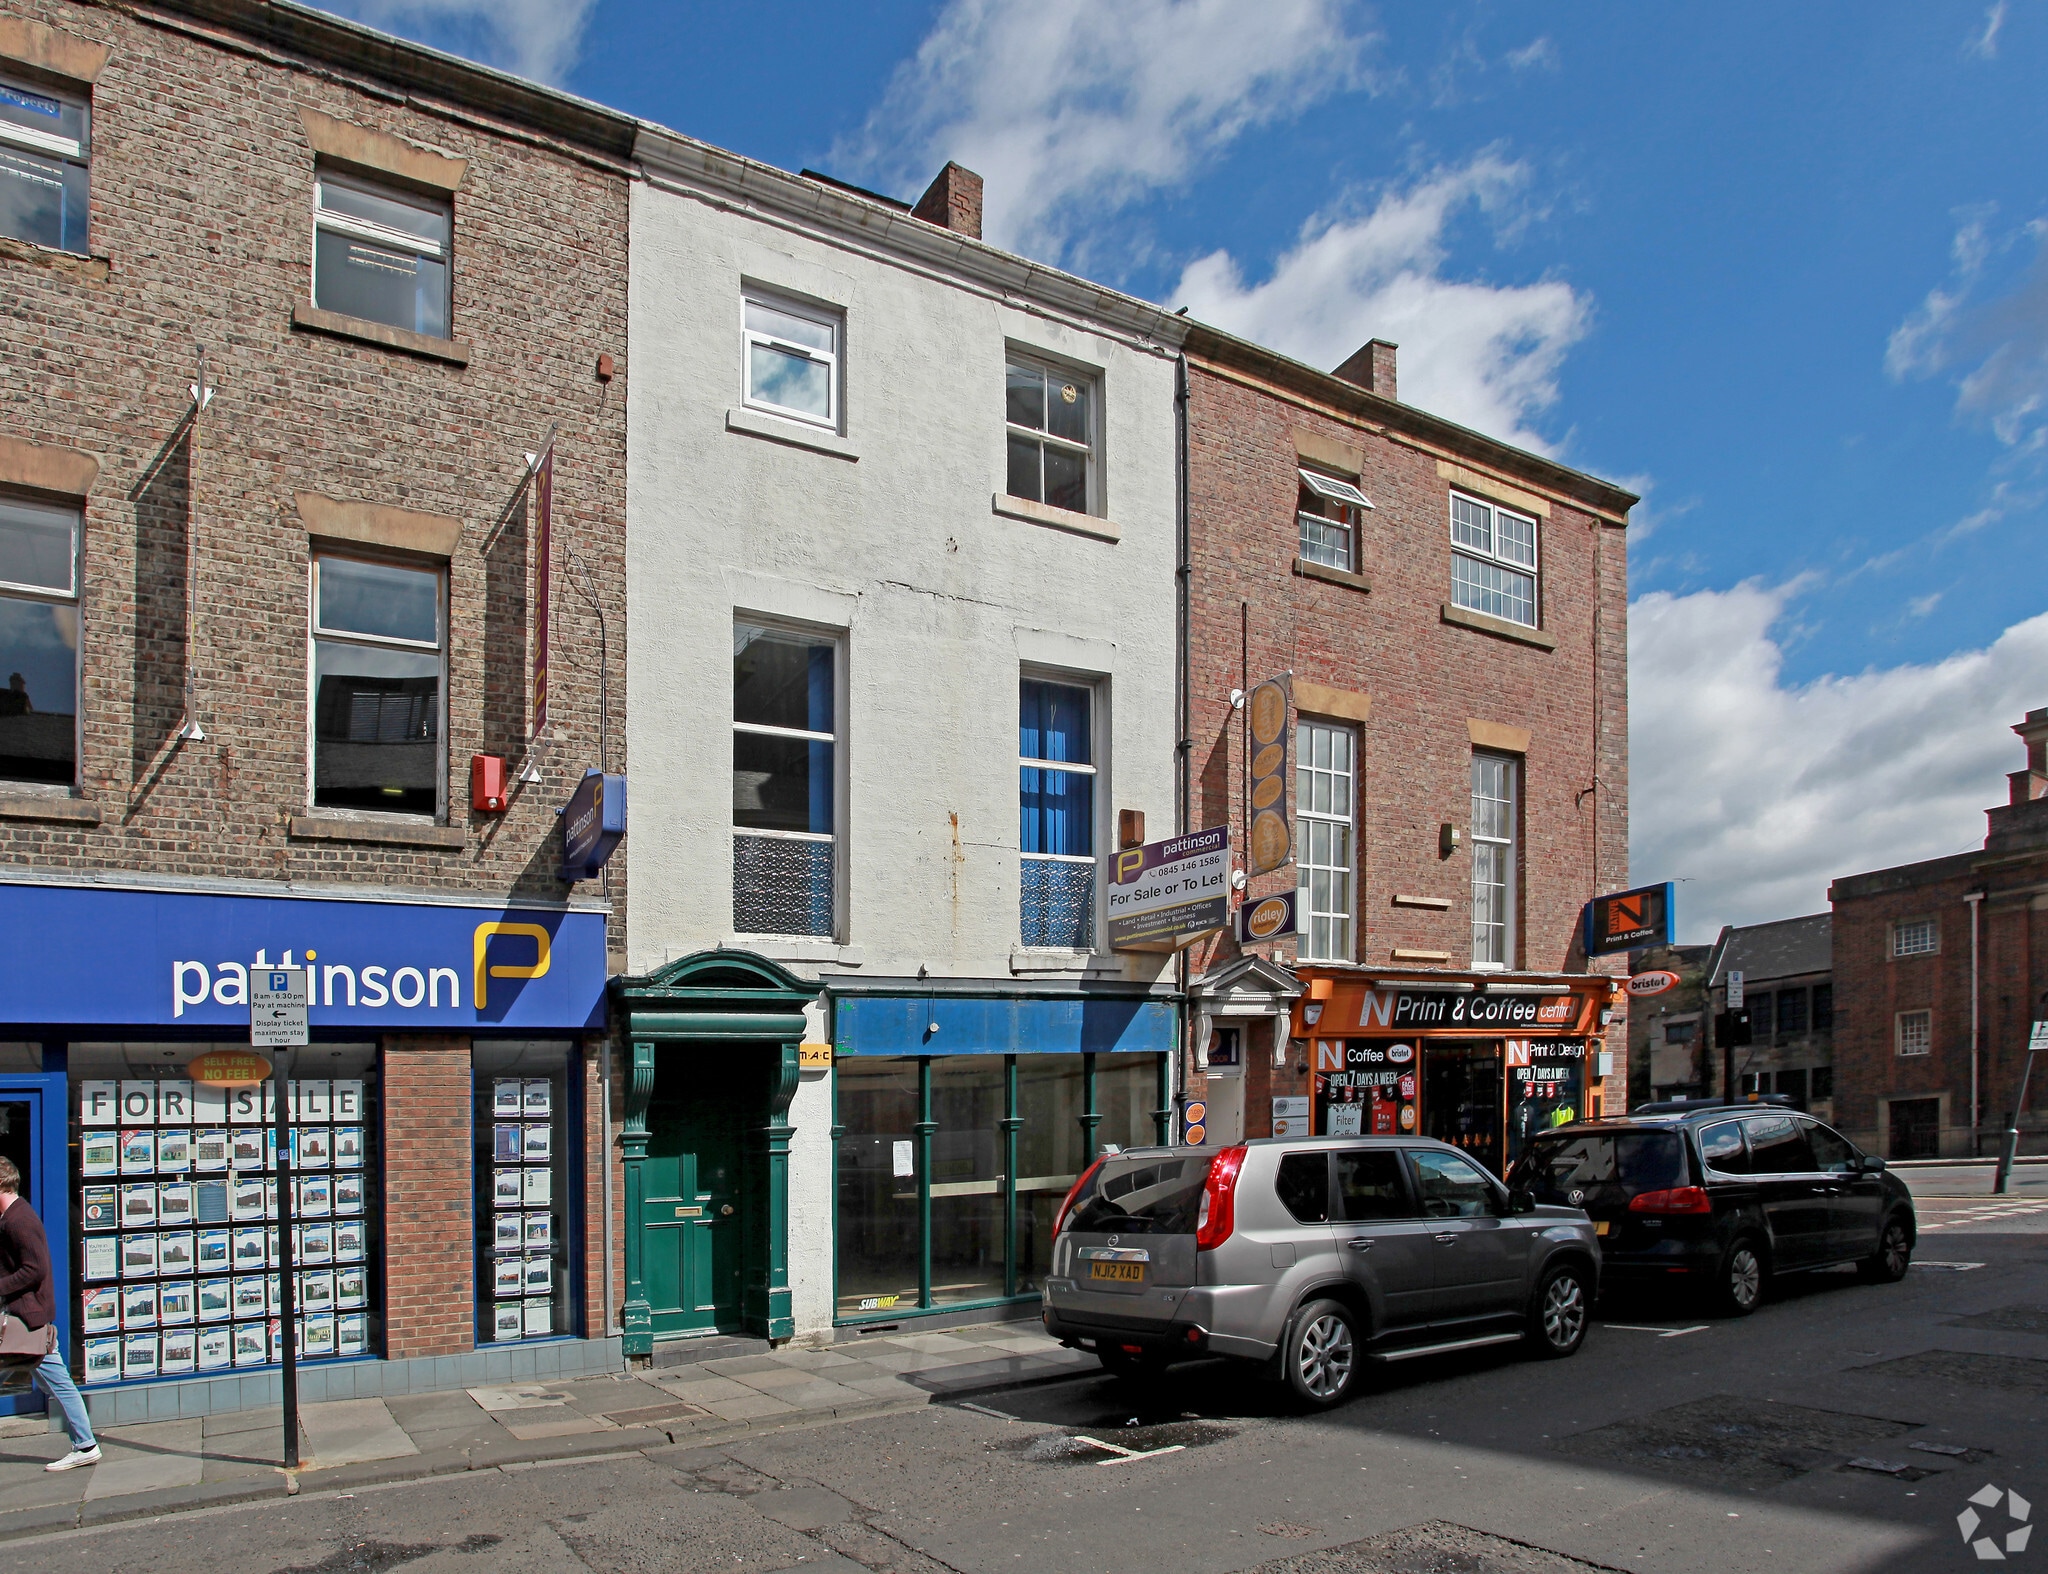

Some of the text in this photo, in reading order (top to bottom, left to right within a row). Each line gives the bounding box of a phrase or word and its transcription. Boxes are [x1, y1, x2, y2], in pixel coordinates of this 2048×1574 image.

[566, 807, 594, 847] pattinson
[1163, 833, 1220, 858] pattinson
[1182, 844, 1220, 857] commercial
[1158, 855, 1220, 877] 0845 146 1586
[1110, 872, 1224, 906] For Sale or To Let
[1122, 902, 1212, 926] Land Retail Industrial Offices
[1136, 919, 1167, 930] Investment
[1171, 912, 1196, 922] Business
[1253, 909, 1283, 924] ridley
[1605, 935, 1623, 943] Print
[1630, 928, 1654, 938] Coffee
[1631, 976, 1666, 990] bristot
[1395, 996, 1446, 1021] Print
[1451, 996, 1465, 1021] &
[1469, 996, 1536, 1020] Coffee
[1539, 1001, 1577, 1019] central
[1347, 1048, 1384, 1062] Coffee
[1529, 1043, 1549, 1057] Print
[1549, 1043, 1557, 1056] &
[1558, 1042, 1585, 1058] Design
[203, 1056, 256, 1067] SELL FREE
[203, 1069, 223, 1080] NO
[226, 1068, 250, 1080] FEE
[1330, 1073, 1348, 1087] OPEN
[1349, 1069, 1356, 1089] 7
[1356, 1073, 1374, 1086] DAYS
[1373, 1072, 1379, 1086] A
[1379, 1071, 1398, 1085] WEEK
[1516, 1067, 1531, 1080] OPEN
[1531, 1064, 1538, 1082] 7
[1537, 1067, 1551, 1080] DAYS
[1556, 1067, 1570, 1080] WEEK
[90, 1089, 185, 1117] FOR
[1336, 1114, 1356, 1126] Filter
[1401, 1109, 1415, 1119] NO
[1094, 1264, 1140, 1280] NJ12 XAD
[858, 1294, 900, 1311] SUBWAY
